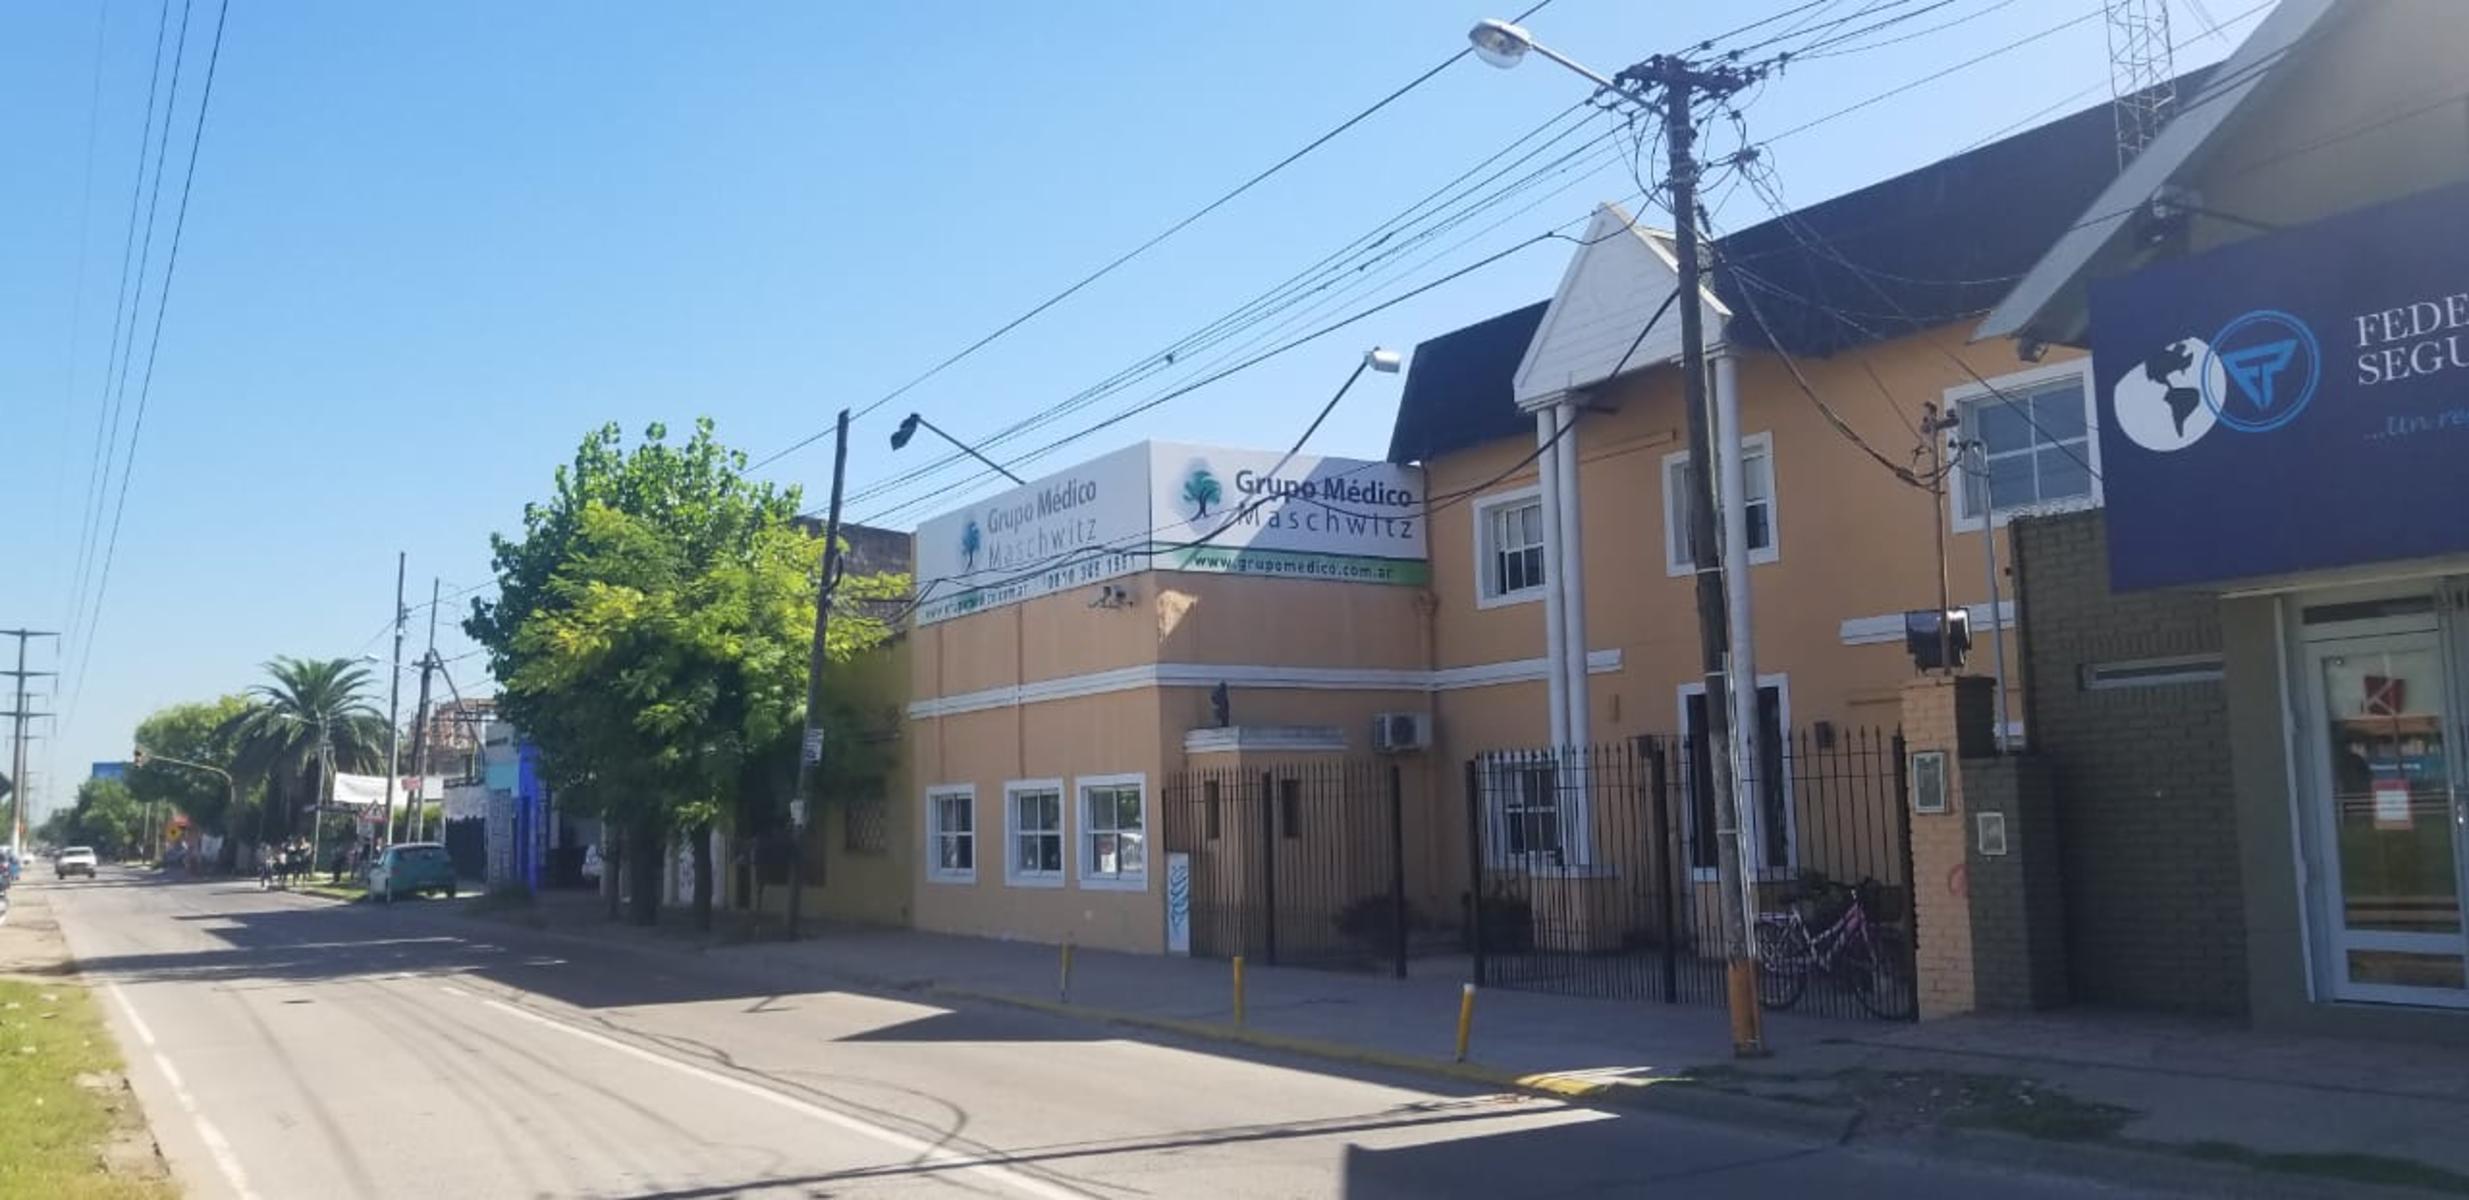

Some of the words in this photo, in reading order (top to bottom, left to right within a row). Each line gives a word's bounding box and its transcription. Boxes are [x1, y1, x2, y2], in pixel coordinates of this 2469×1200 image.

[987, 507, 1034, 536] Grupo
[1037, 478, 1097, 519] Médico
[1236, 470, 1316, 504] Grupo
[1324, 477, 1413, 508] Médico
[1238, 507, 1413, 539] Maschwitz
[988, 518, 1097, 569] Maschwitz
[1194, 554, 1393, 581] www.grupomedico.com.ar
